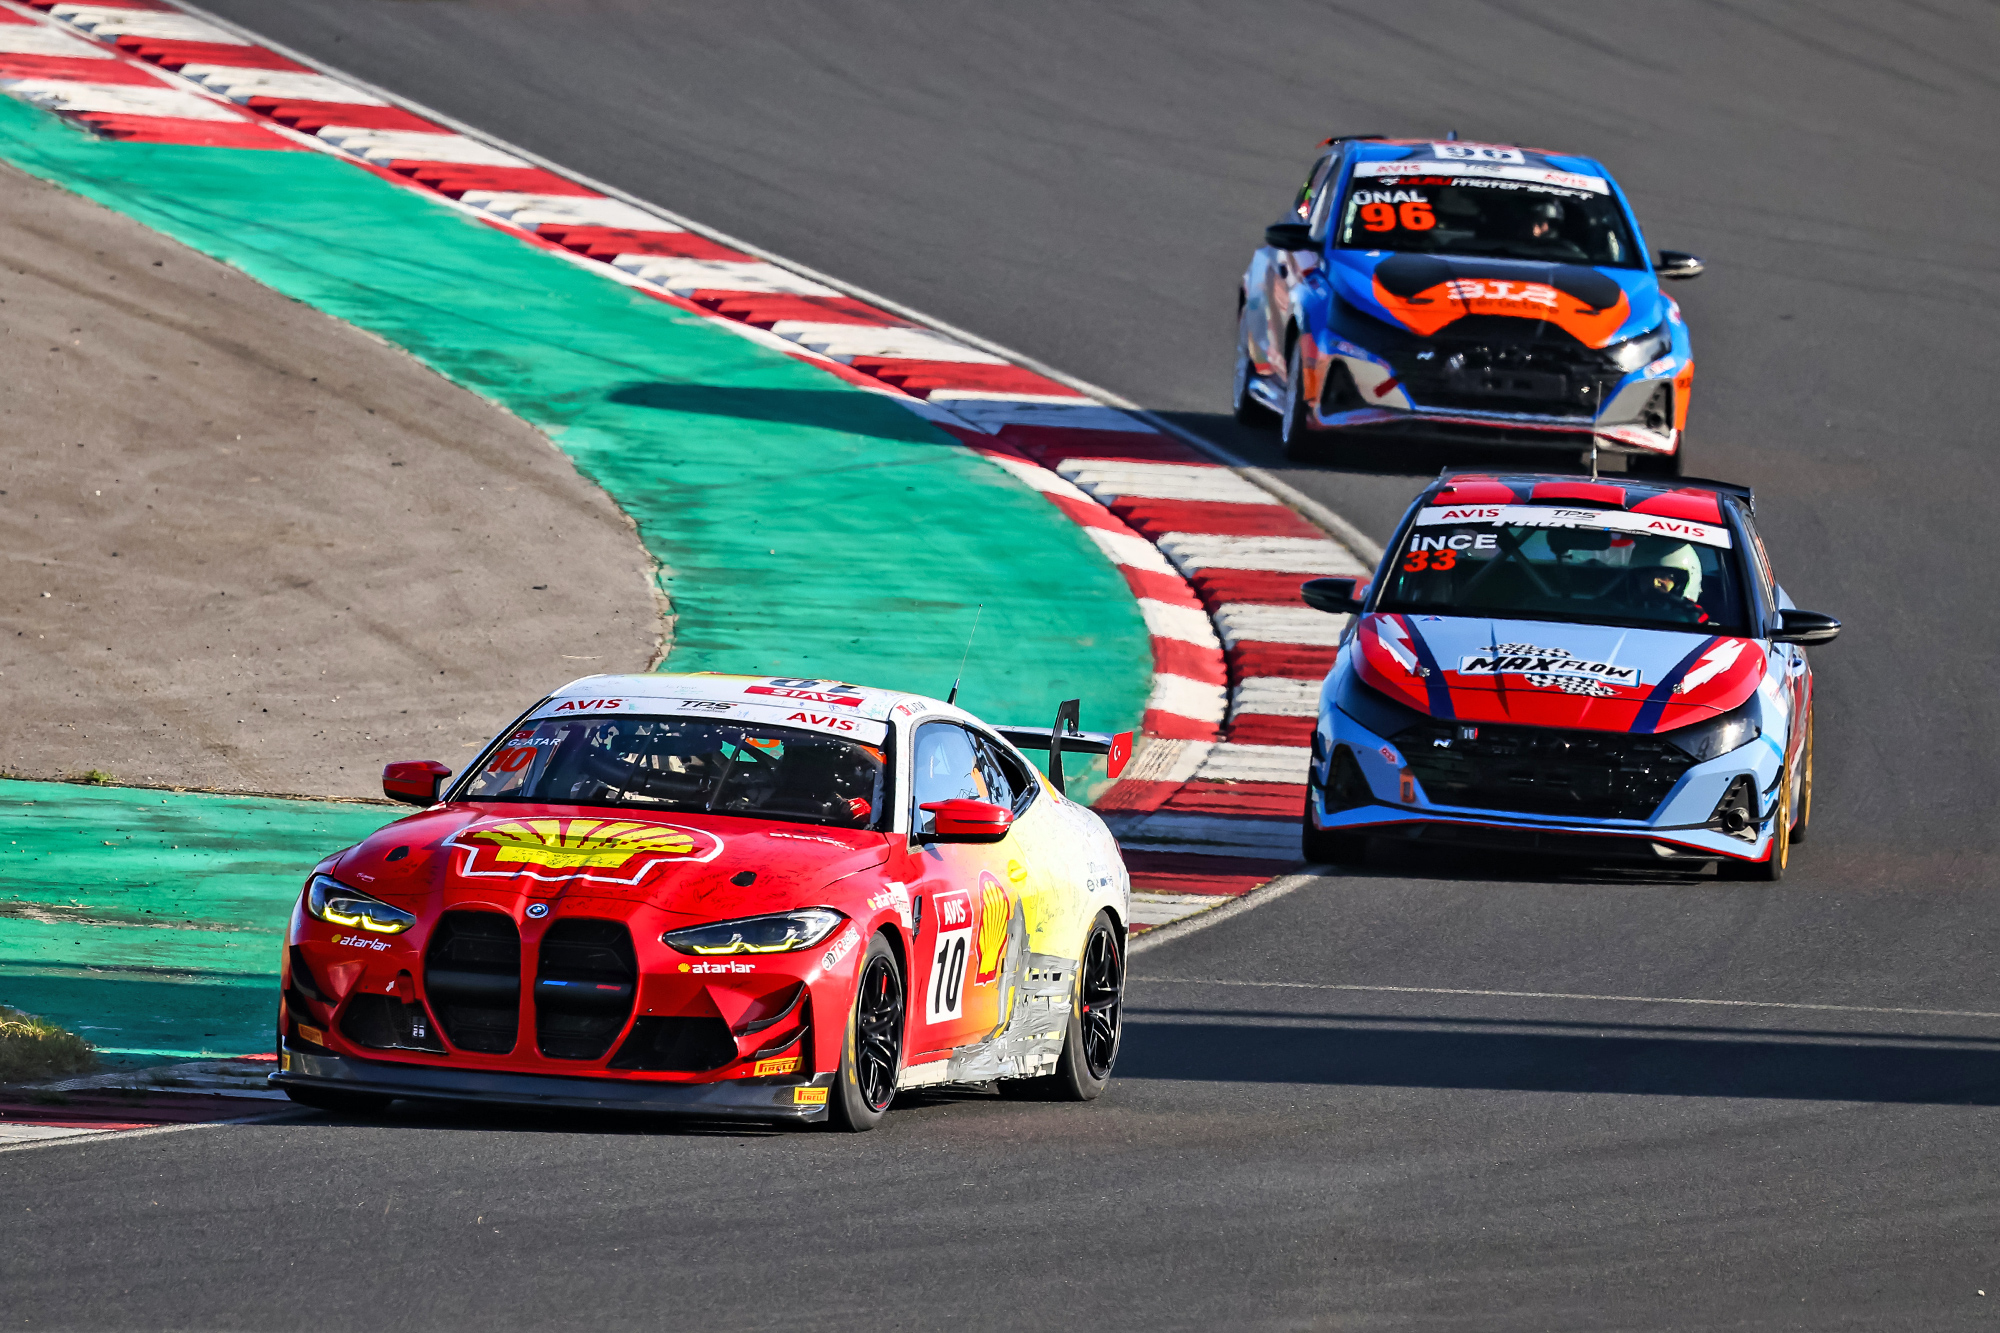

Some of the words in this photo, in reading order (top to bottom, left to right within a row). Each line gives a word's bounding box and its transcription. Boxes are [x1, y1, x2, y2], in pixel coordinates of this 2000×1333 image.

[1376, 164, 1421, 173] AVIS
[1544, 173, 1588, 188] AVIS
[1361, 202, 1436, 232] 96
[1442, 508, 1500, 519] AVIS
[1647, 520, 1705, 537] AVIS
[1403, 548, 1457, 573] 33
[771, 688, 844, 703] AVIS
[554, 698, 623, 712] AVIS
[786, 711, 856, 731] AVIS
[525, 738, 561, 746] ATAR
[487, 746, 538, 773] 10
[943, 898, 966, 926] AVIS
[340, 934, 391, 951] atarlar
[692, 961, 756, 974] atarlar
[934, 936, 966, 1015] 10
[798, 1090, 826, 1101] PIRELLI
